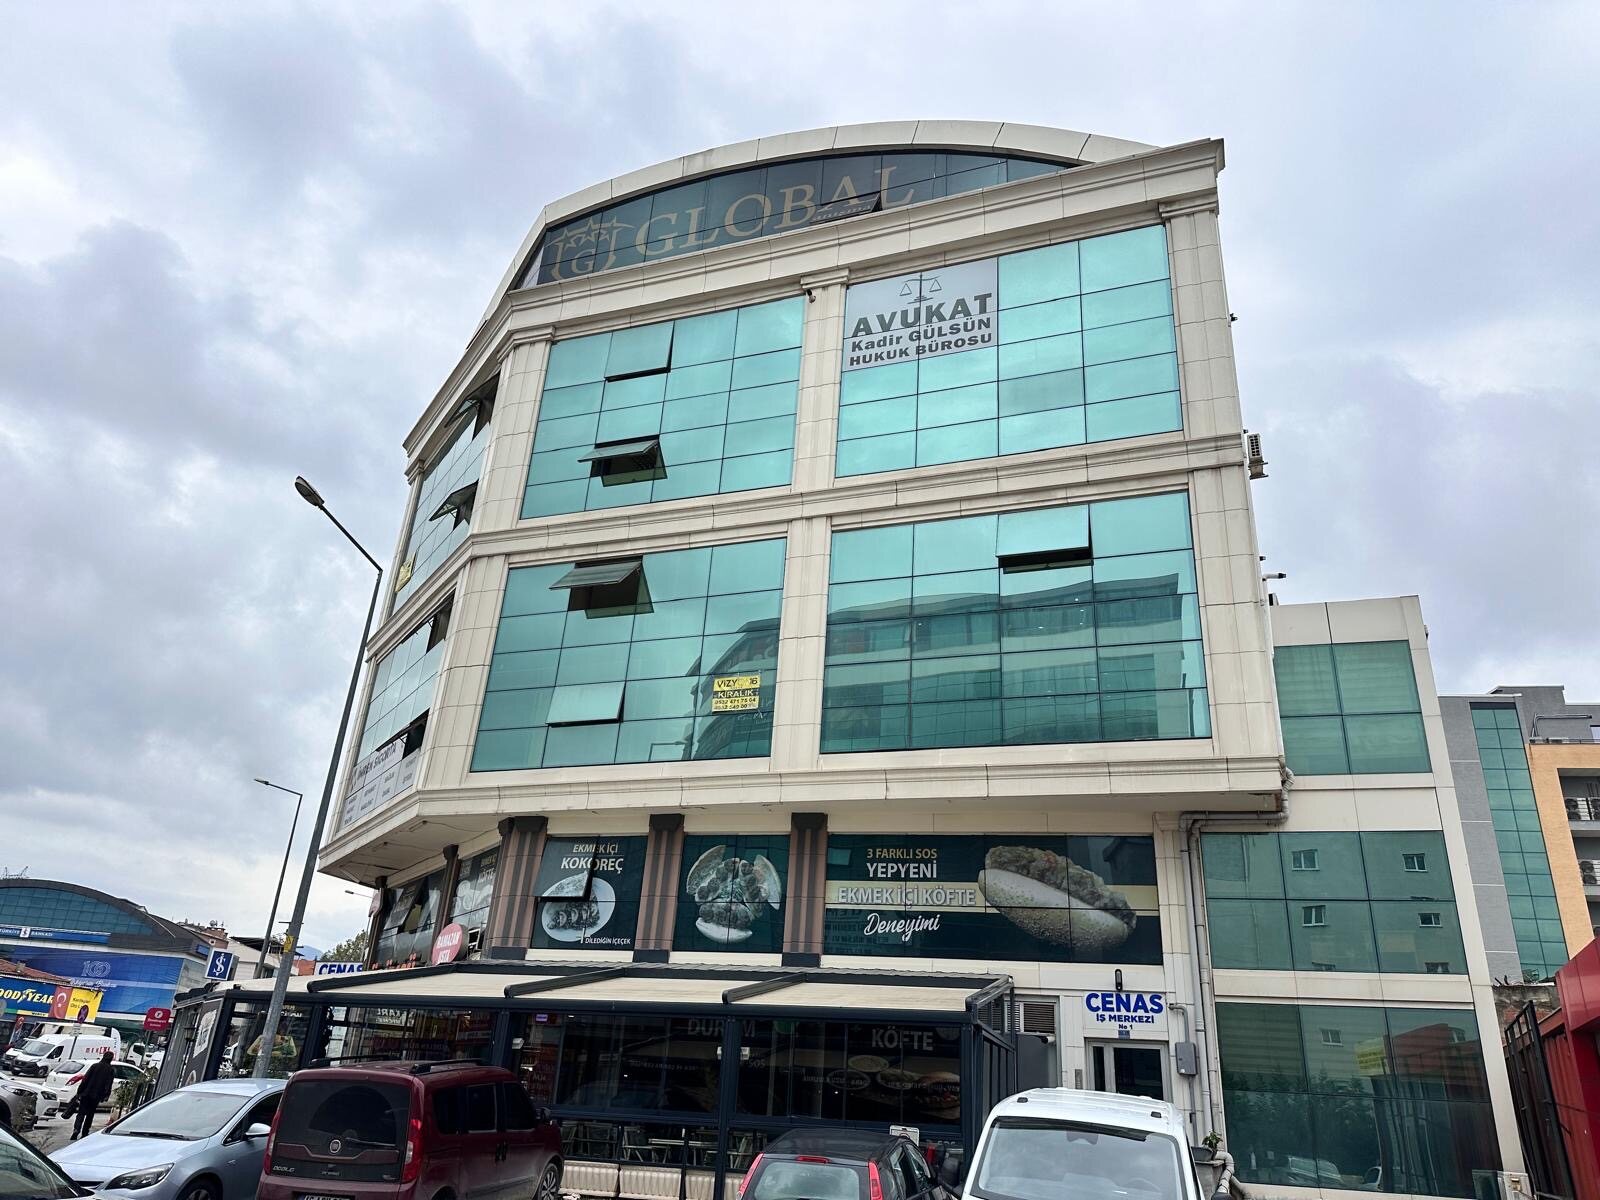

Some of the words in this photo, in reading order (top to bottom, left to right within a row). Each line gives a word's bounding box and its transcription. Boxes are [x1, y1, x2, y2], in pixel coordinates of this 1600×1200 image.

[634, 166, 915, 257] GLOBAL
[852, 292, 992, 338] AVUKAT
[851, 334, 903, 352] Kadir
[908, 317, 991, 342] GÜLSÜN
[849, 347, 910, 367] HUKUK
[915, 333, 992, 355] BÜROSU
[866, 849, 873, 858] 3
[876, 849, 913, 859] FARKLI
[915, 849, 937, 859] SOS
[866, 860, 937, 878] YEPYENİ
[838, 887, 893, 904] EKMEK
[896, 885, 918, 909] İÇİ
[923, 886, 976, 905] KÖFTE
[863, 913, 940, 941] Deneyimi
[1085, 992, 1164, 1014] CENAS
[1096, 1013, 1106, 1023] İŞ
[1108, 1014, 1154, 1024] MERKEZİ
[871, 1025, 934, 1052] KÖFTE
